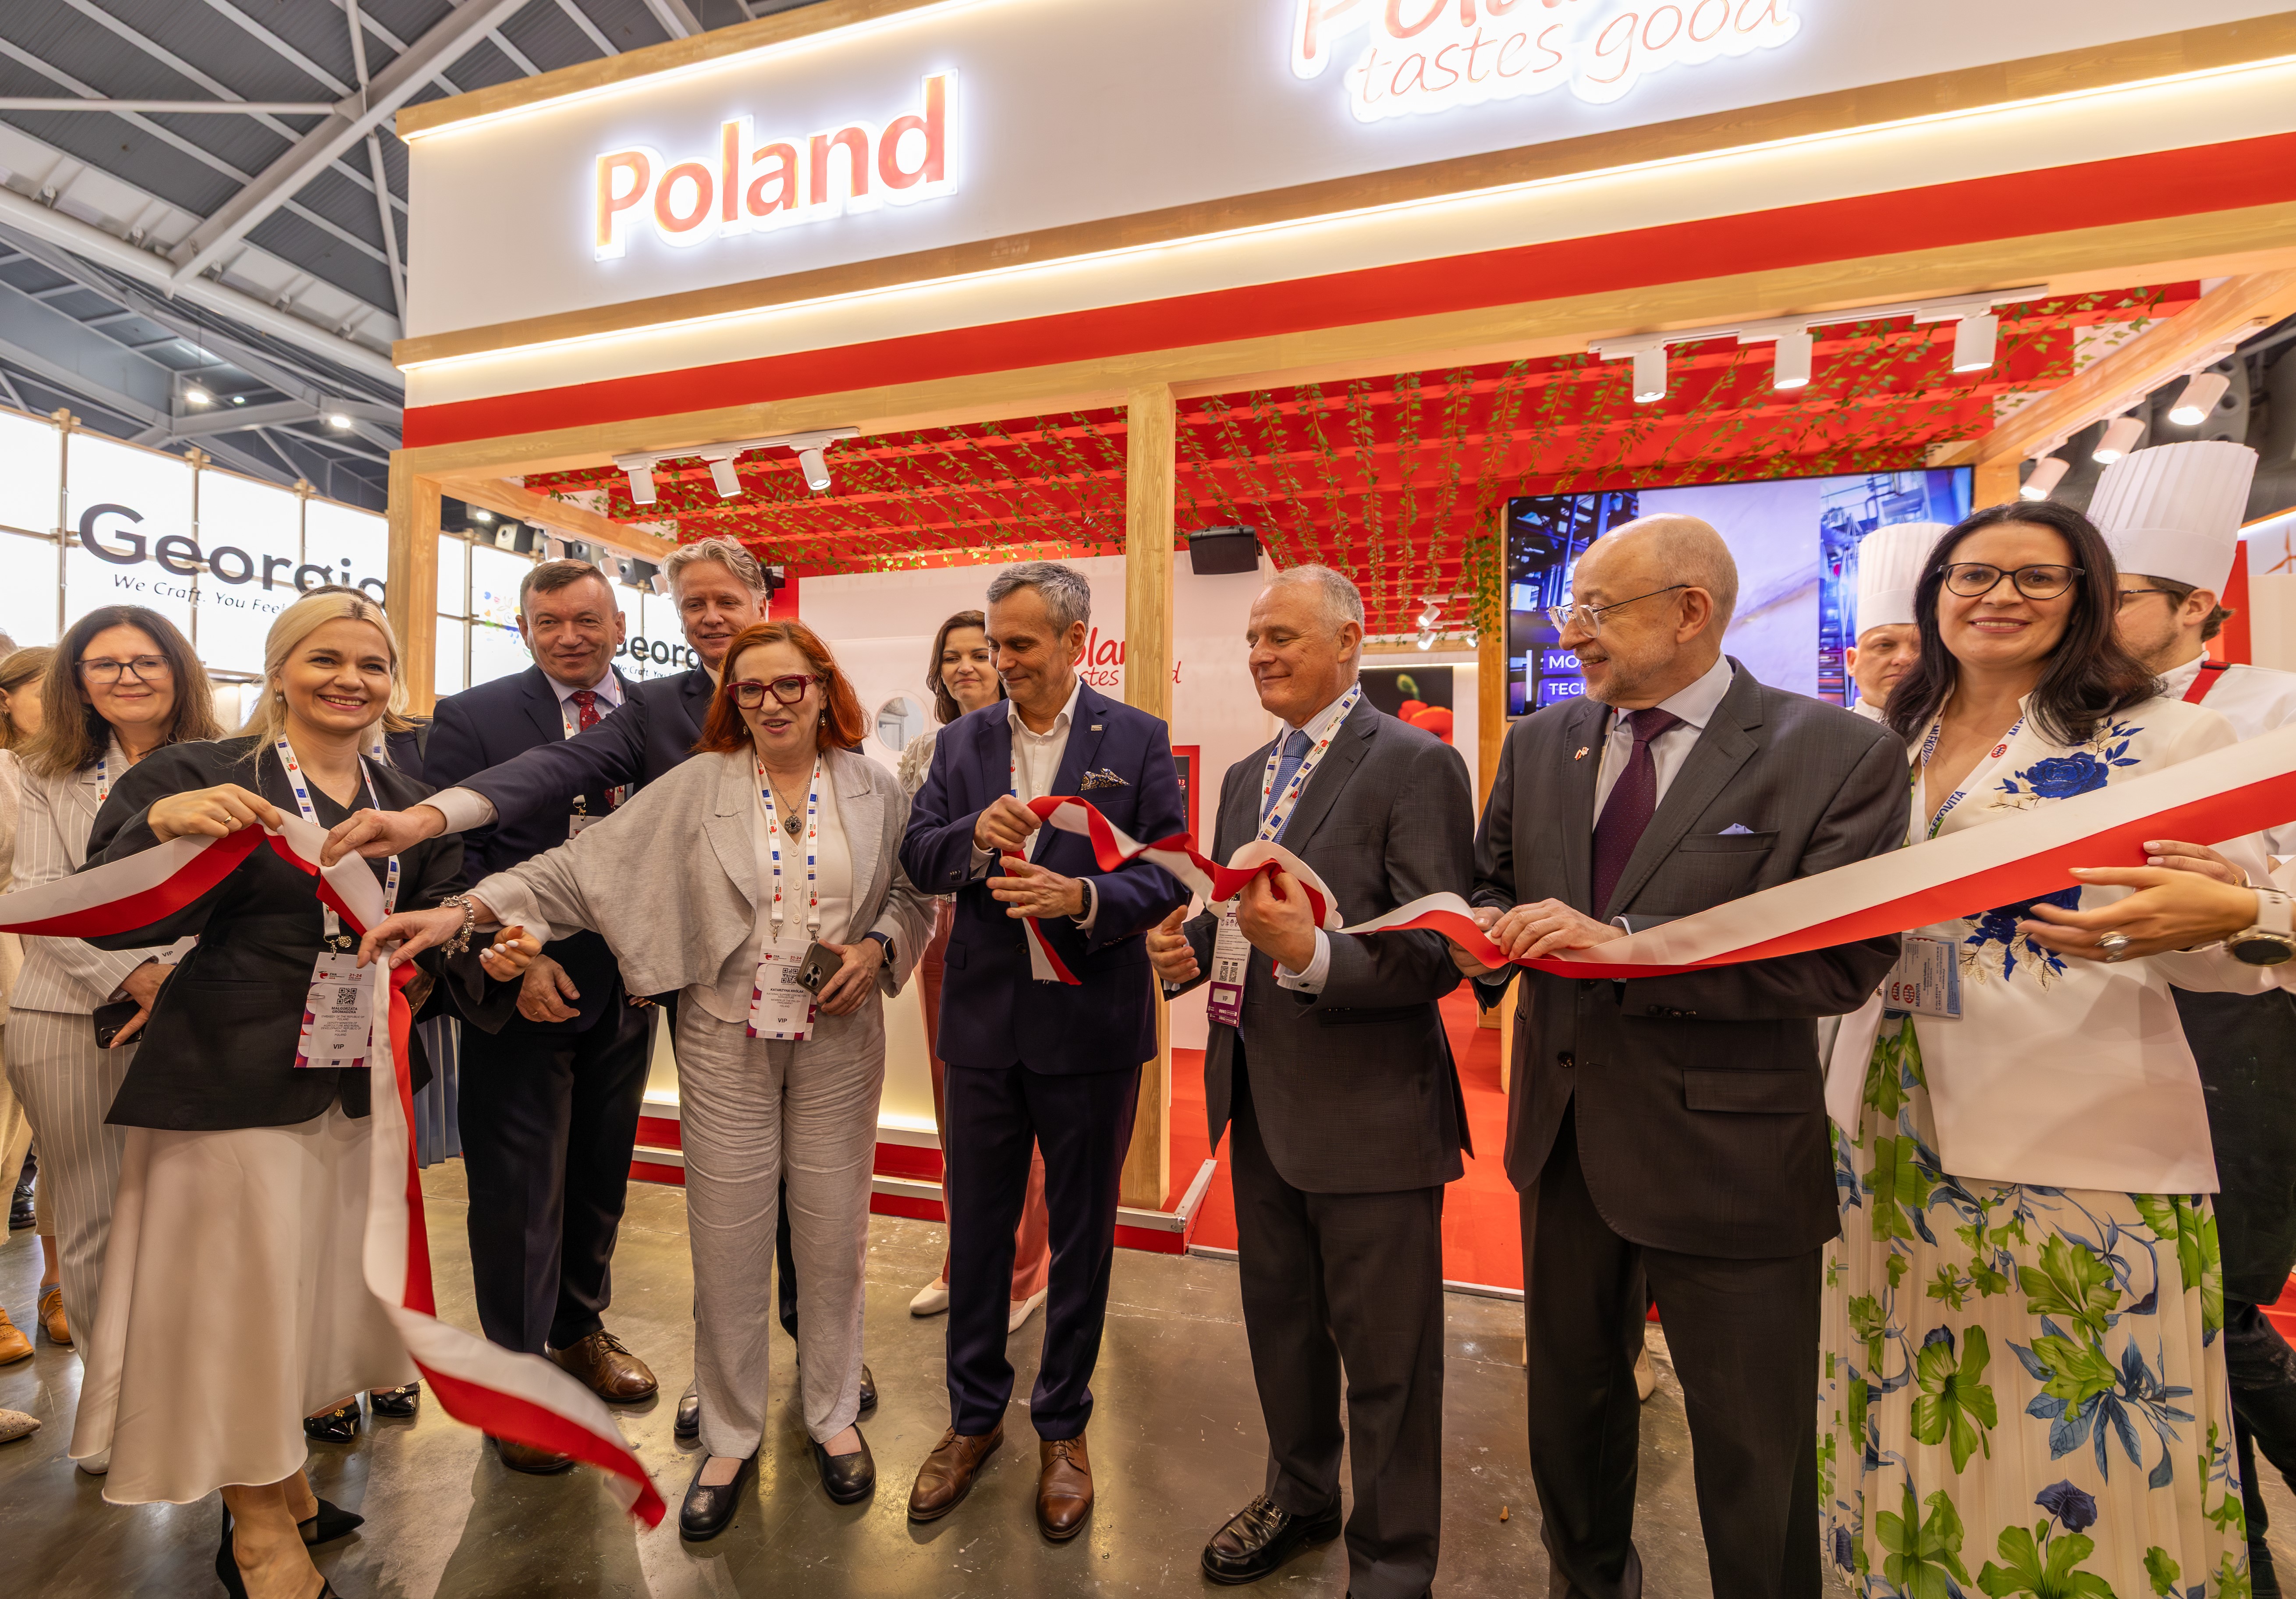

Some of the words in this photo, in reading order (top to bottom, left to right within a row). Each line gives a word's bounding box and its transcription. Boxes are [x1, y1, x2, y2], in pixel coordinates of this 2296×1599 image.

[1357, 24, 1563, 103] tastes
[596, 75, 945, 247] Poland
[115, 574, 145, 592] We
[216, 592, 245, 609] You
[1080, 667, 1119, 686] stes
[1549, 655, 1581, 669] MO
